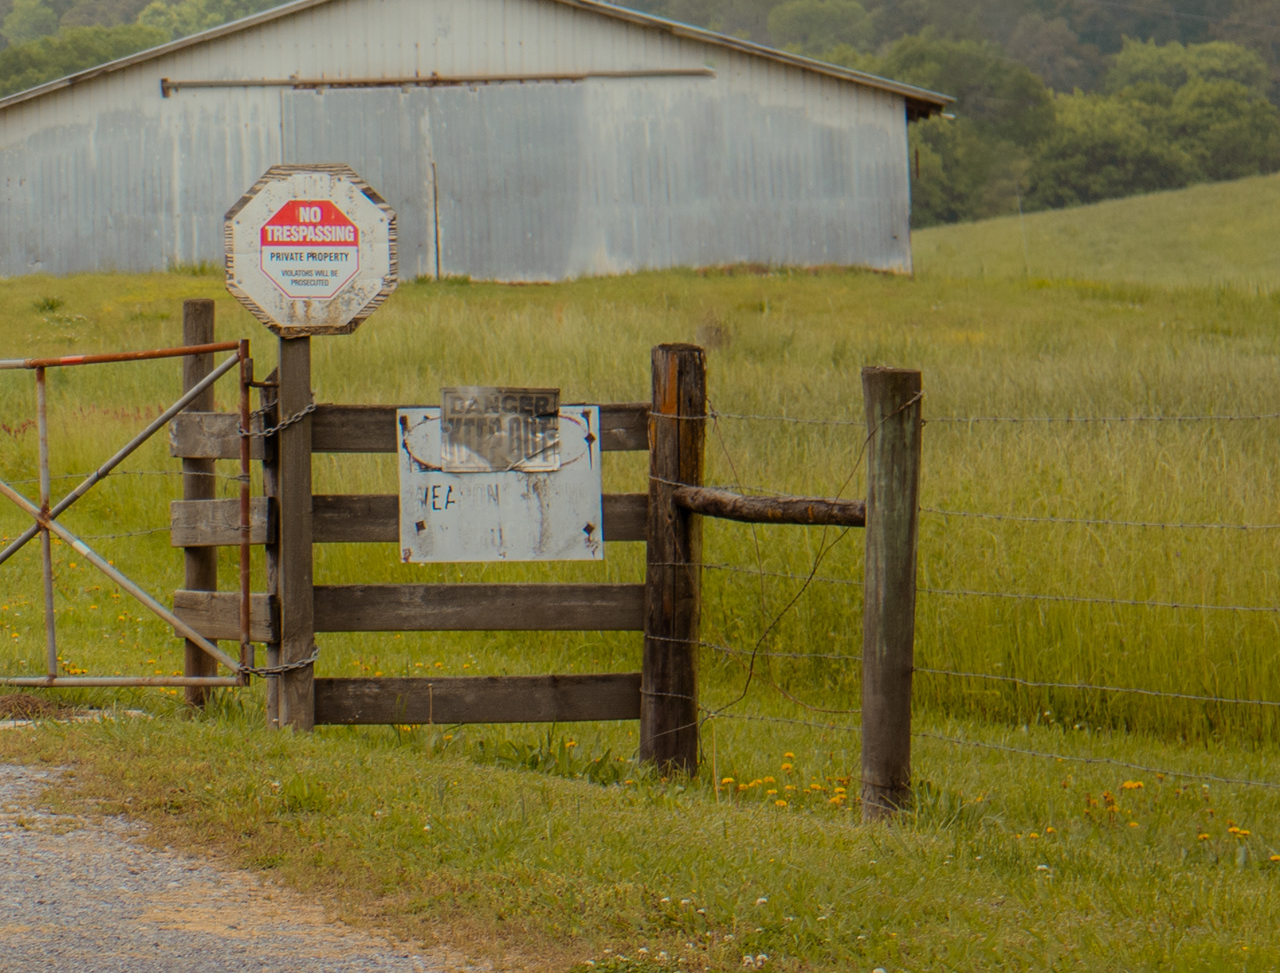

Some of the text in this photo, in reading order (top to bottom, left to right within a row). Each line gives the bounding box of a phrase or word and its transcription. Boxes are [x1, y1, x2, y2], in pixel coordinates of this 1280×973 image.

[299, 206, 322, 223] NO
[265, 225, 355, 242] TRESPASSING
[270, 252, 349, 262] PRIVATE PROPERTY
[281, 269, 338, 277] VIOLATORS WILL BE
[450, 395, 550, 417] DANGER
